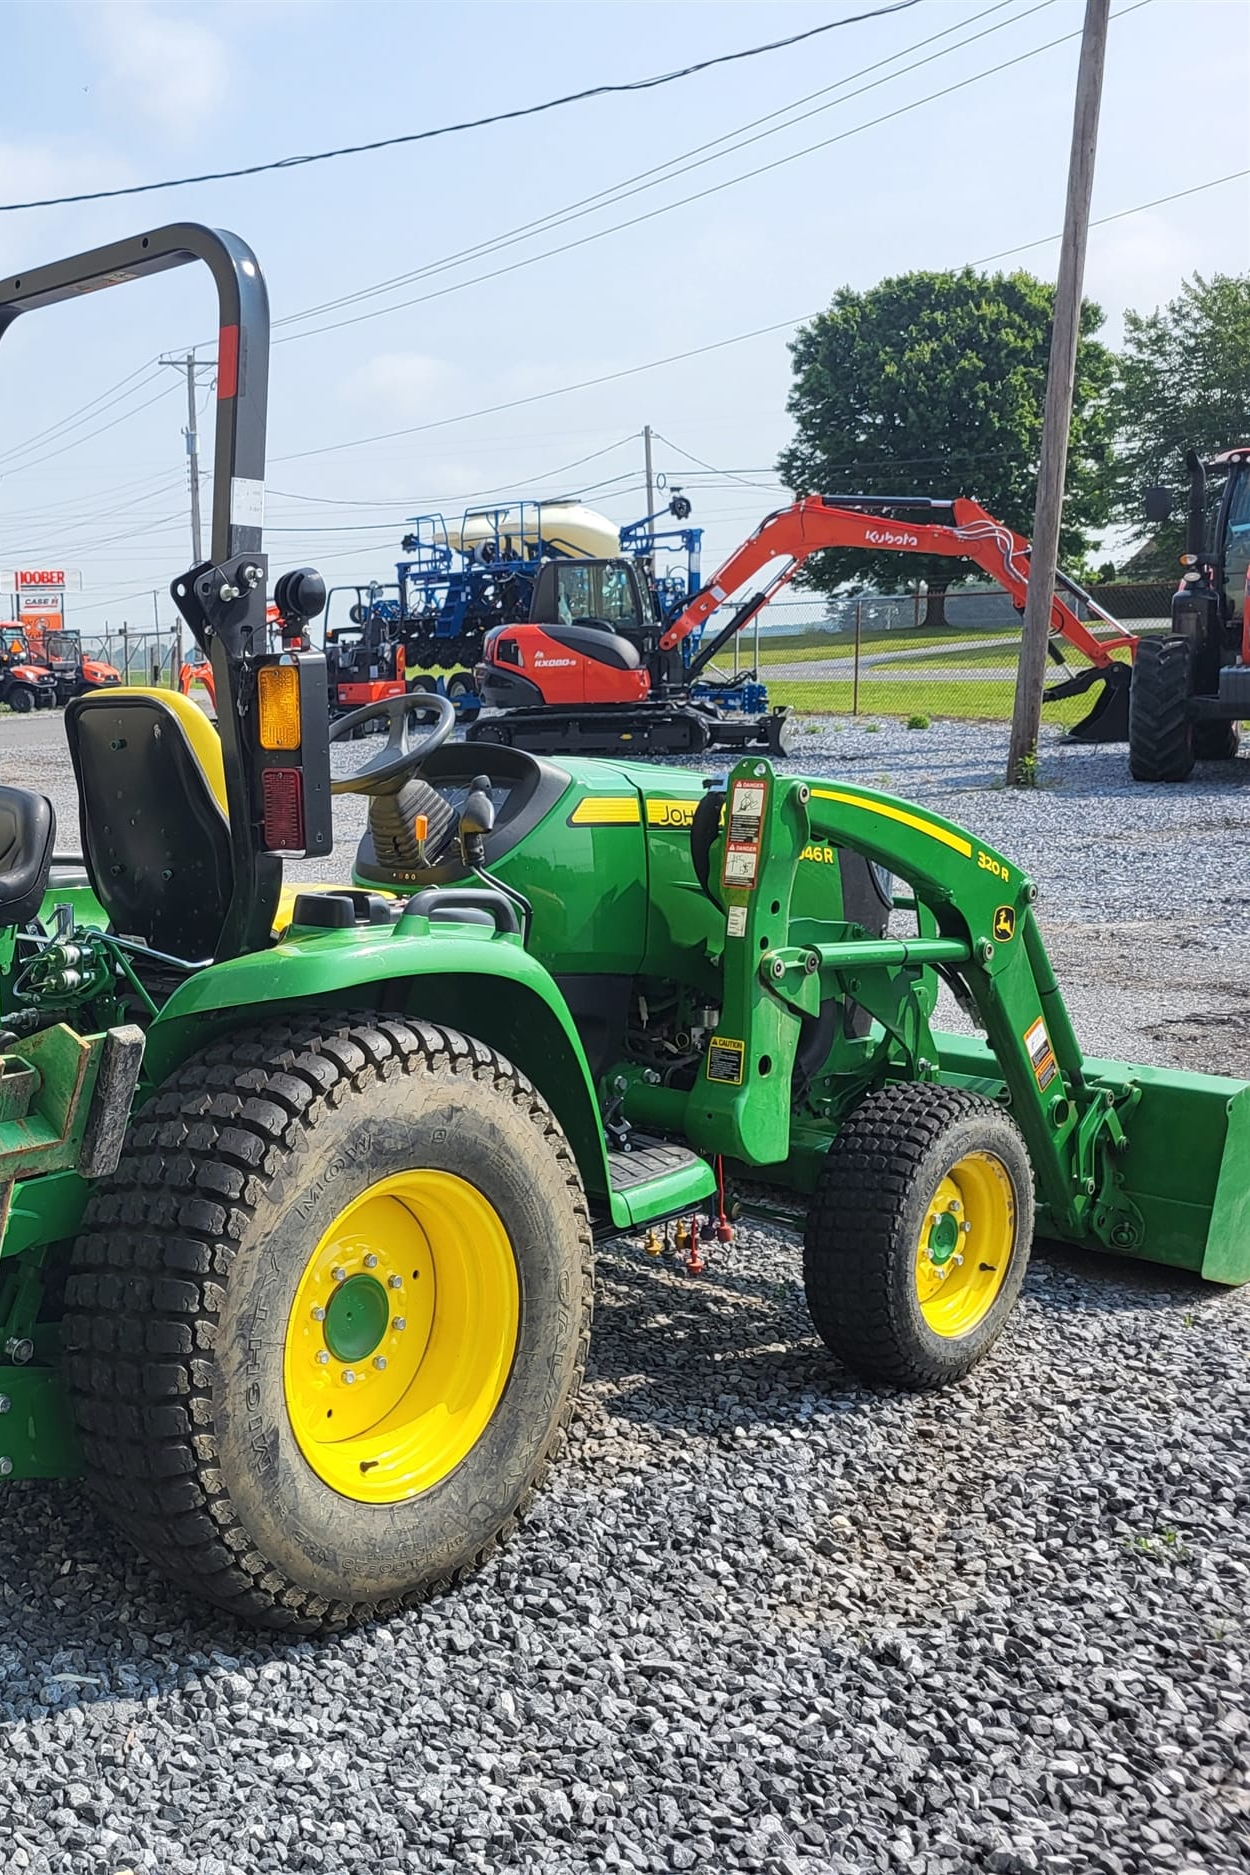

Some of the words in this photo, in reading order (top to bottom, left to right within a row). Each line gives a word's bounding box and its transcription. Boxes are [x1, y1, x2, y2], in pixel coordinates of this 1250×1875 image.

[865, 530, 918, 546] Kubota
[661, 805, 694, 823] JOH
[718, 1040, 743, 1049] CAUTION
[245, 1254, 281, 1476] MIGHTY
